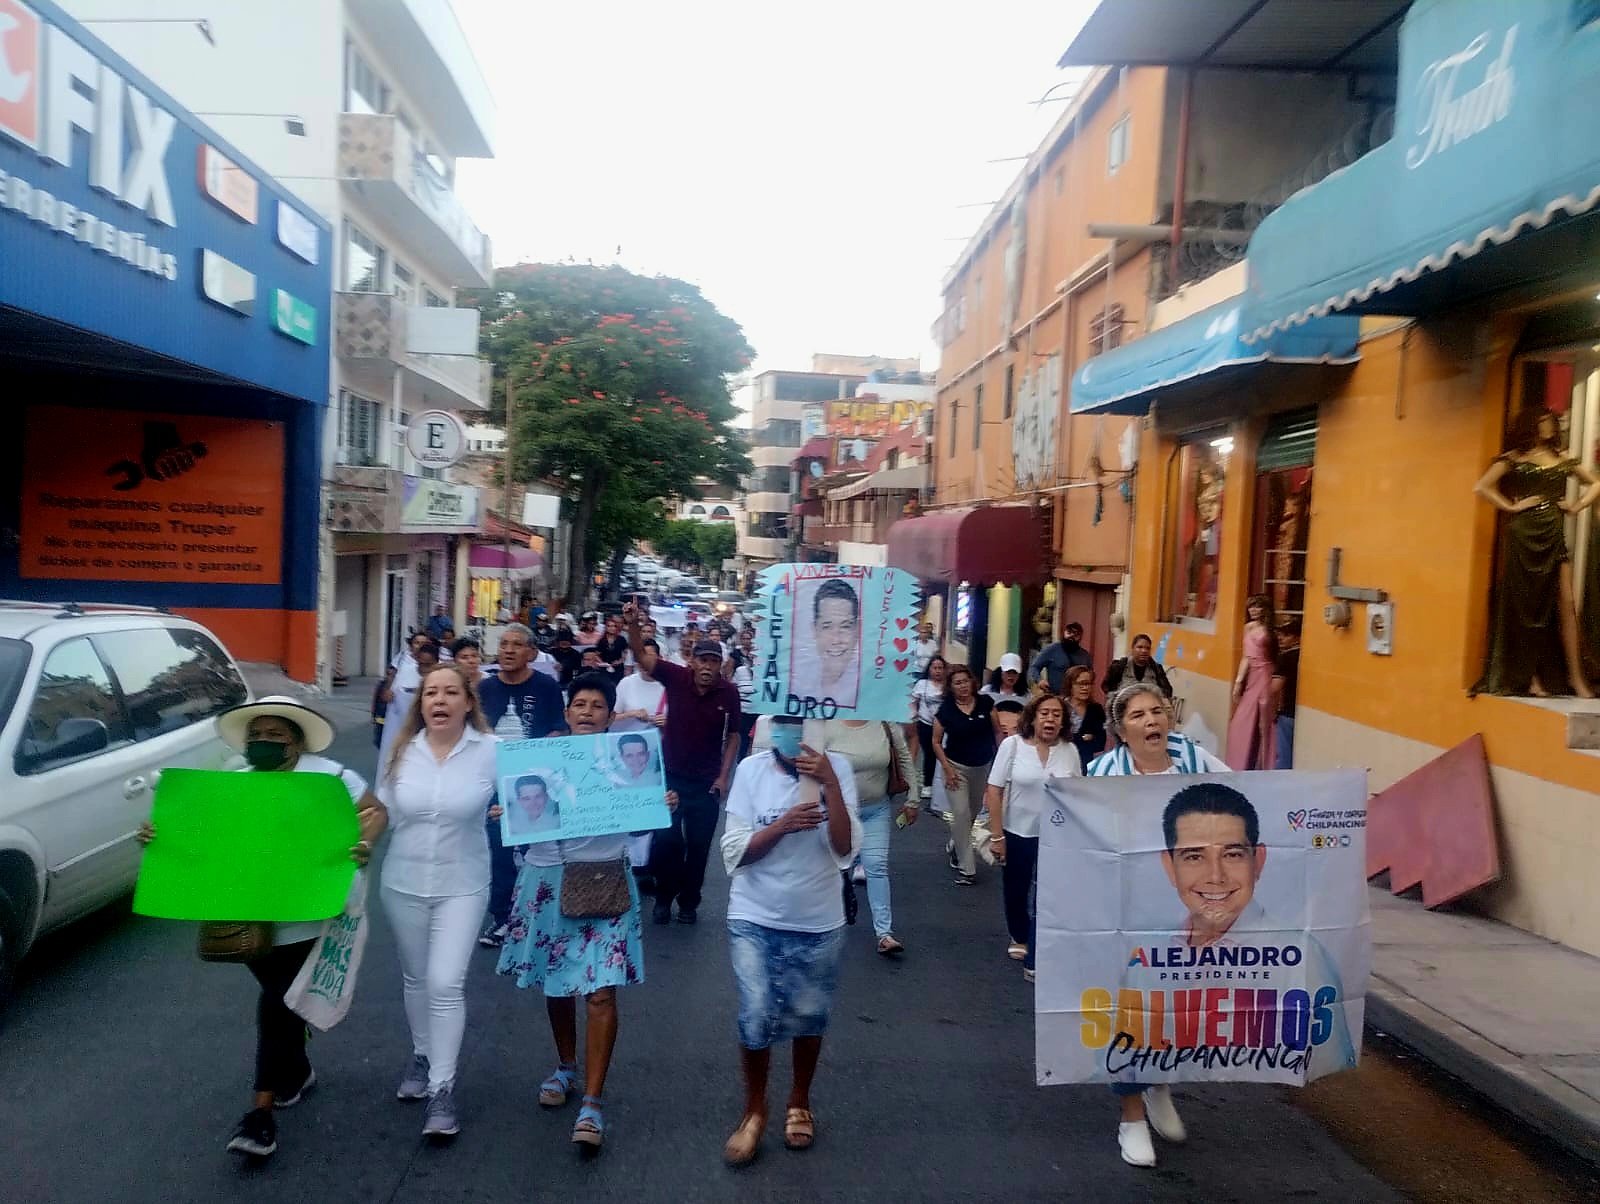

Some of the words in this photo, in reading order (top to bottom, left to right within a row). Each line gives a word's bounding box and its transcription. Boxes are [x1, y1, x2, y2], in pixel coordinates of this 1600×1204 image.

[41, 22, 177, 227] FIX
[427, 422, 445, 449] E
[1128, 945, 1302, 967] ALEJANDRO
[312, 962, 345, 998] VIDA
[1160, 970, 1271, 981] PRESIDENTE
[1080, 986, 1337, 1051] SALVEMOS
[1106, 1031, 1312, 1074] CHILPANCING
